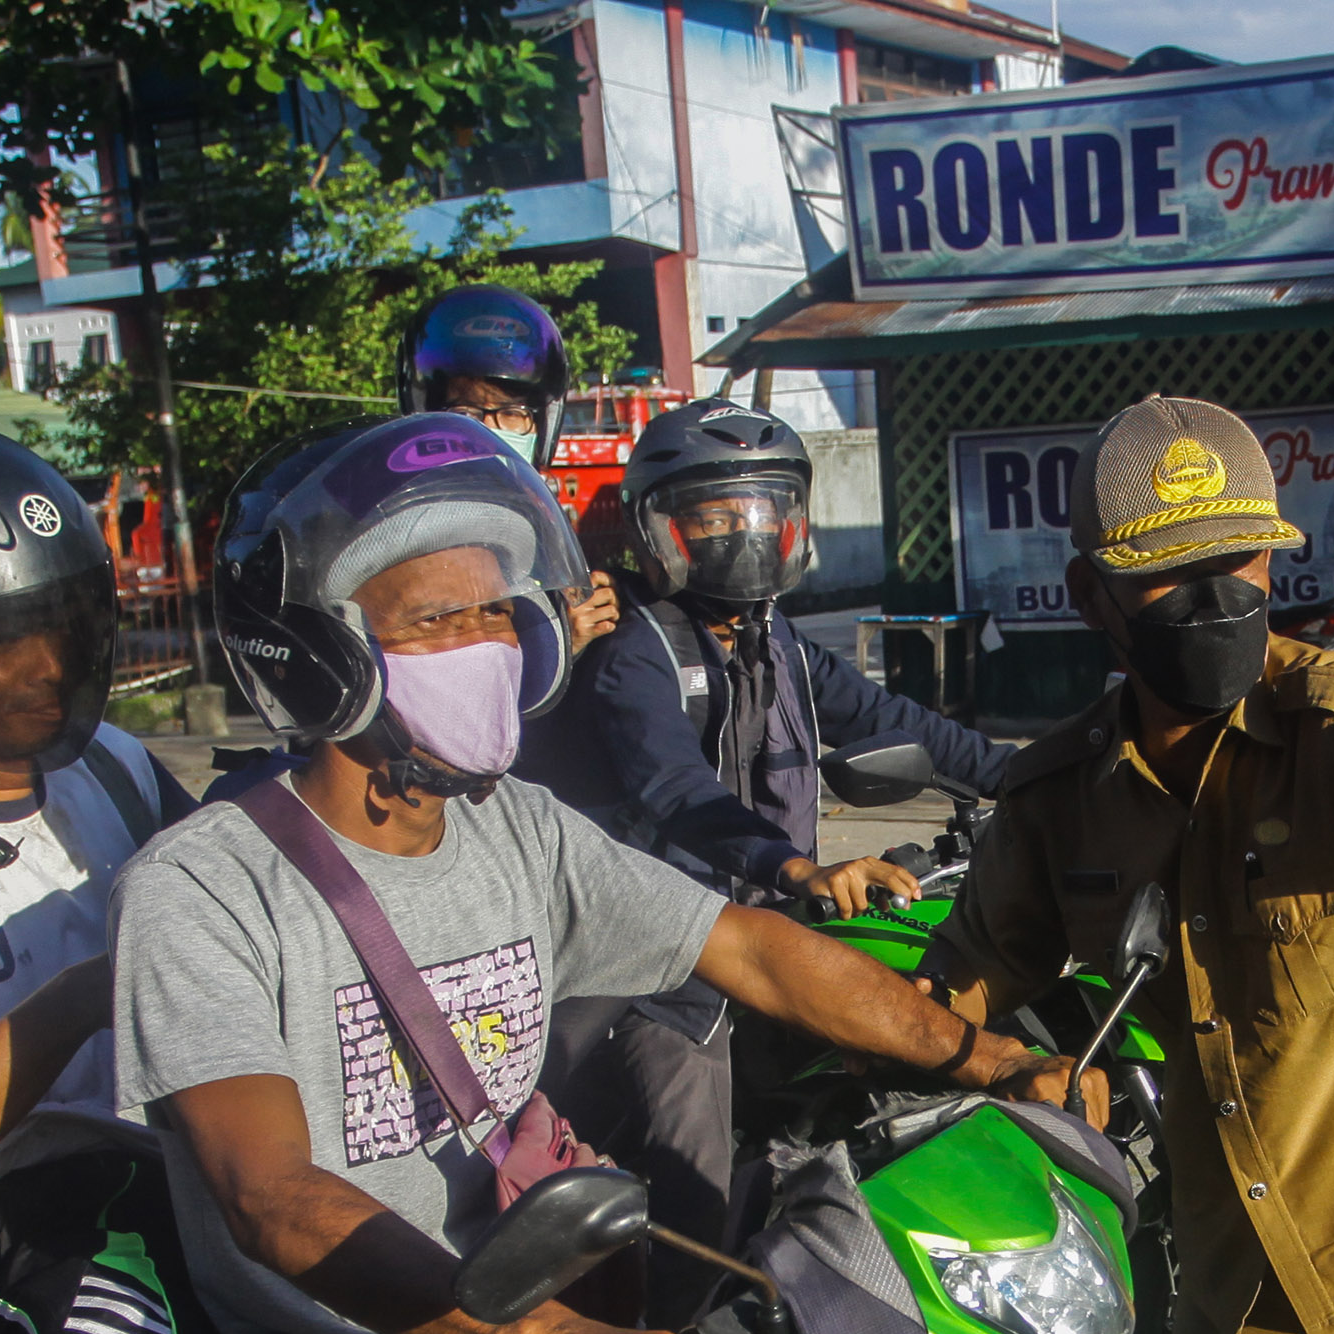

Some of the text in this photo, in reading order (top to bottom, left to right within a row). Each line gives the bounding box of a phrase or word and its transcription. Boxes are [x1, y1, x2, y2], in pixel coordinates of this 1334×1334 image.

[869, 124, 1181, 253] RONDE
[985, 446, 1080, 530] RO
[1016, 584, 1076, 612] BU
